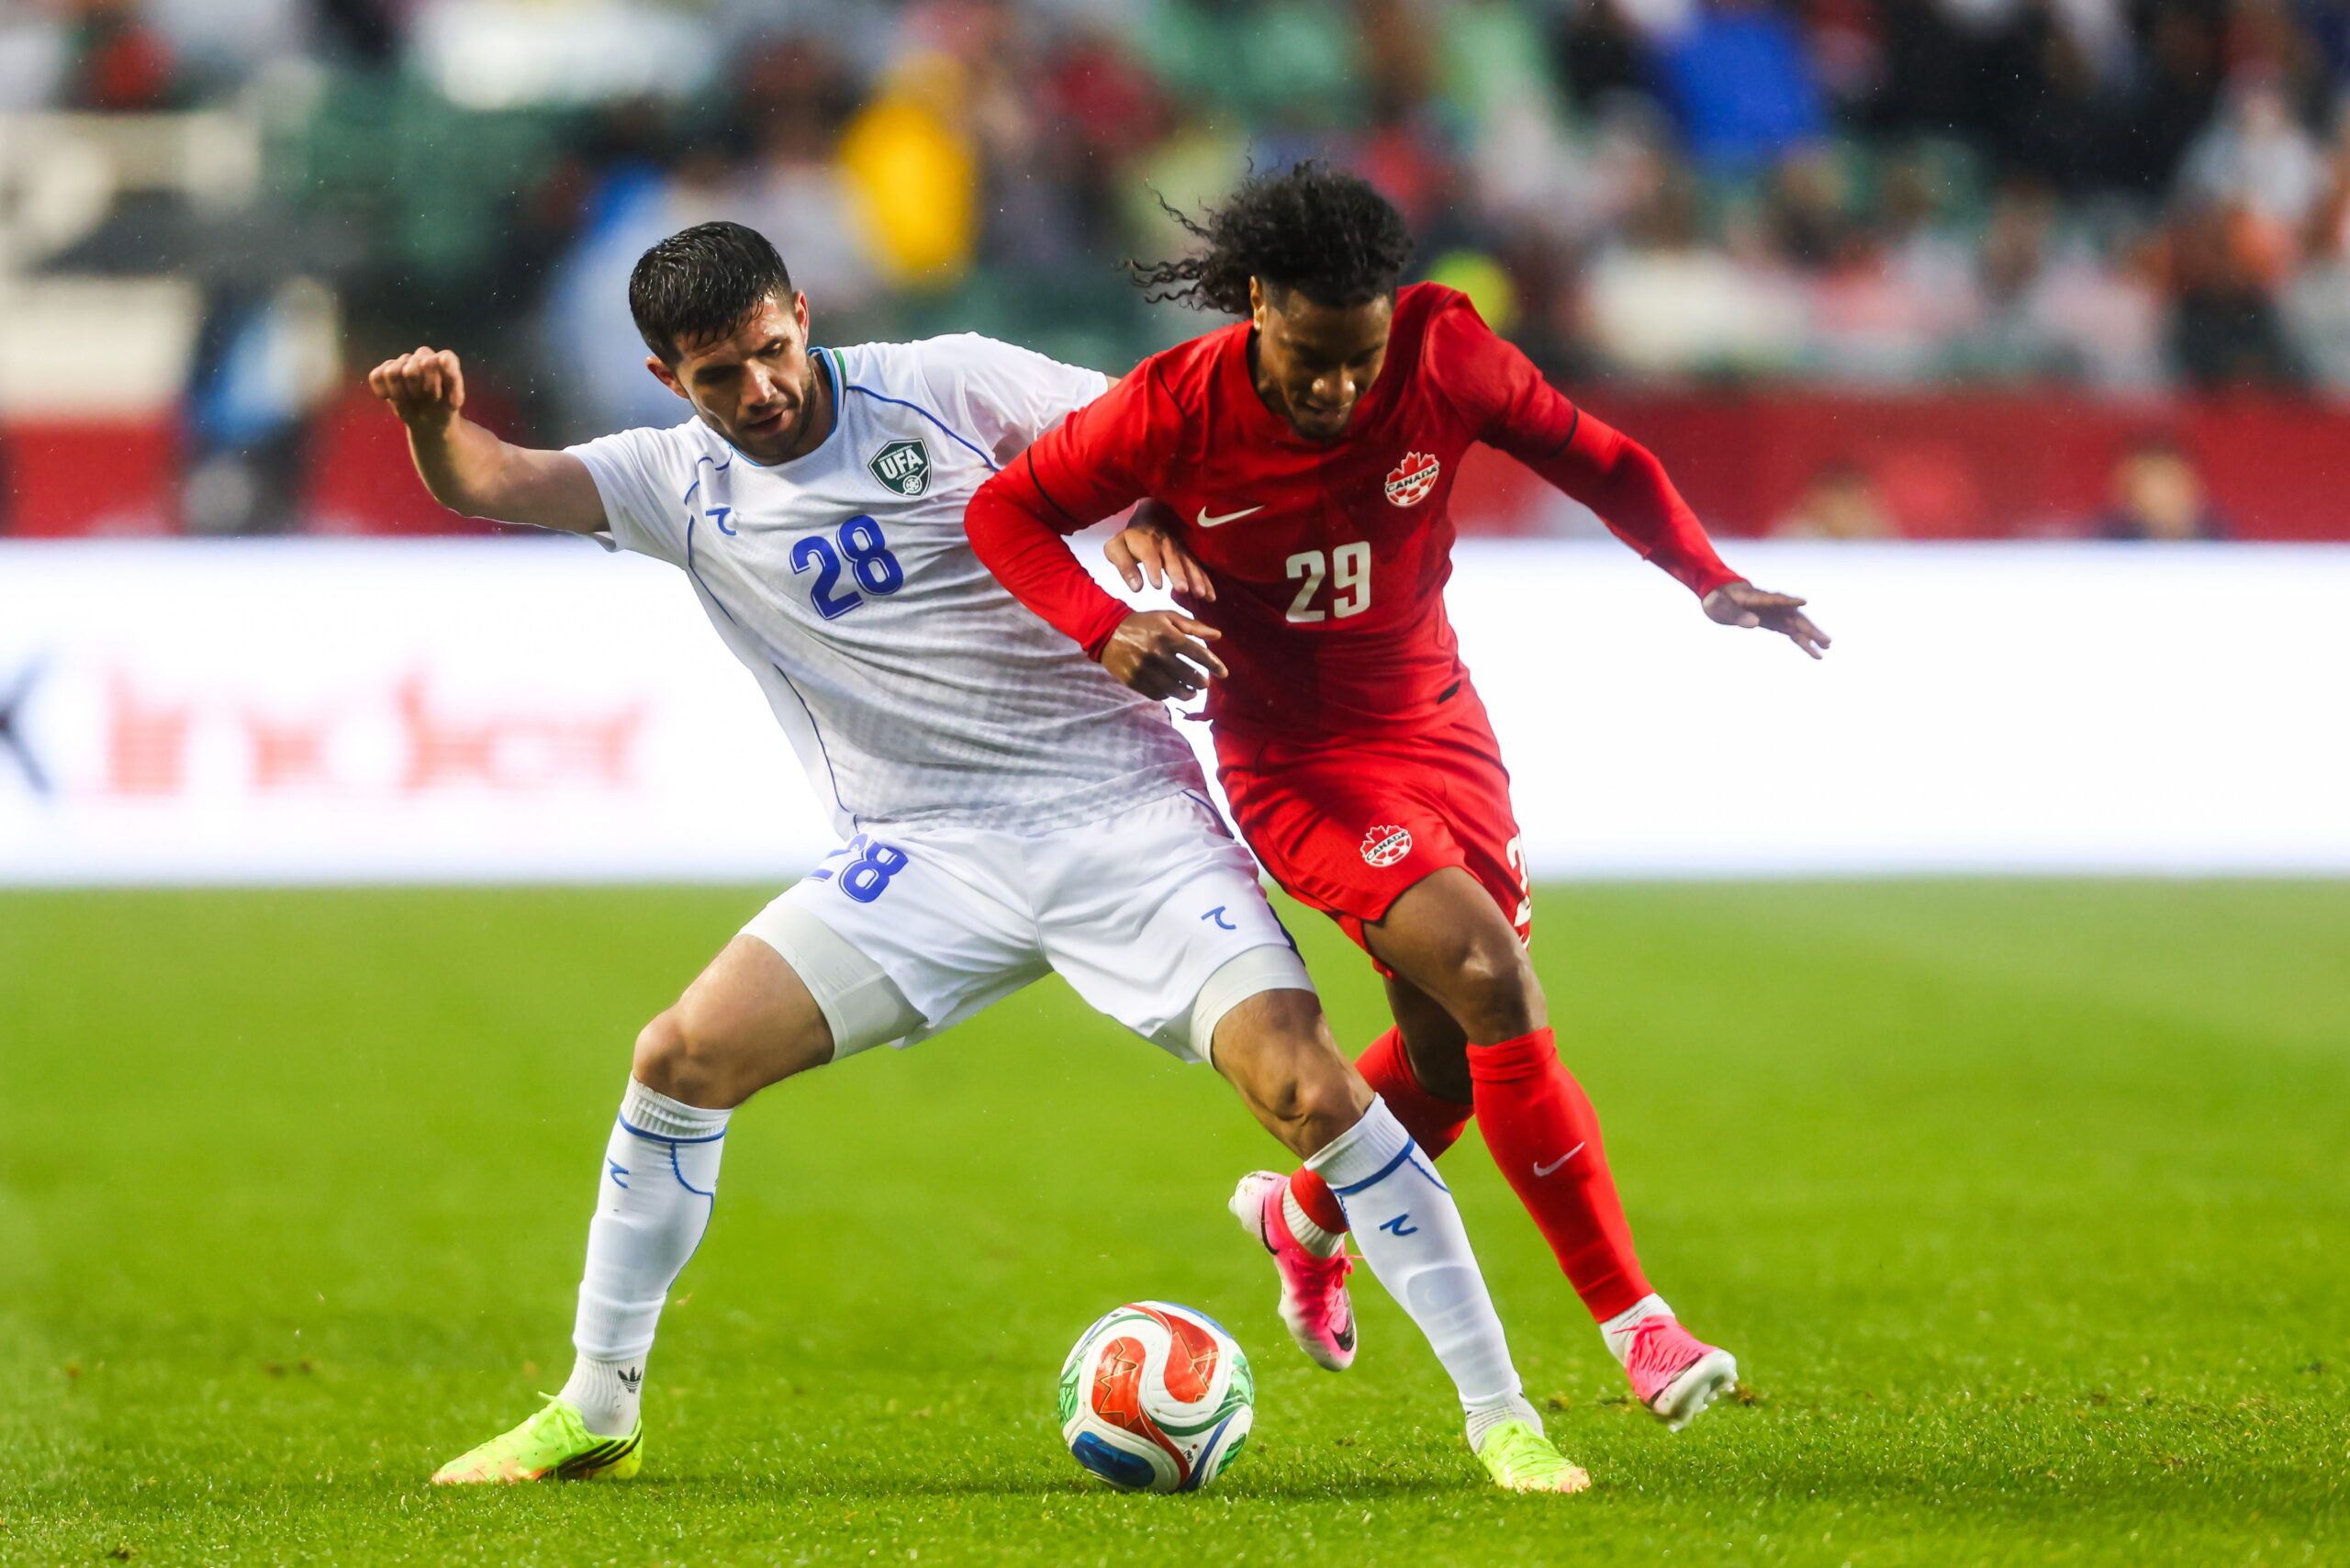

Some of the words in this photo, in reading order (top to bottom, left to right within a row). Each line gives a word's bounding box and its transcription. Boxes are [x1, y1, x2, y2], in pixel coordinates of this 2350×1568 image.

[879, 448, 923, 479] UFA
[1386, 466, 1437, 493] CANADA
[789, 514, 904, 621] 28
[1286, 541, 1371, 623] 29
[1366, 832, 1407, 861] CANADA
